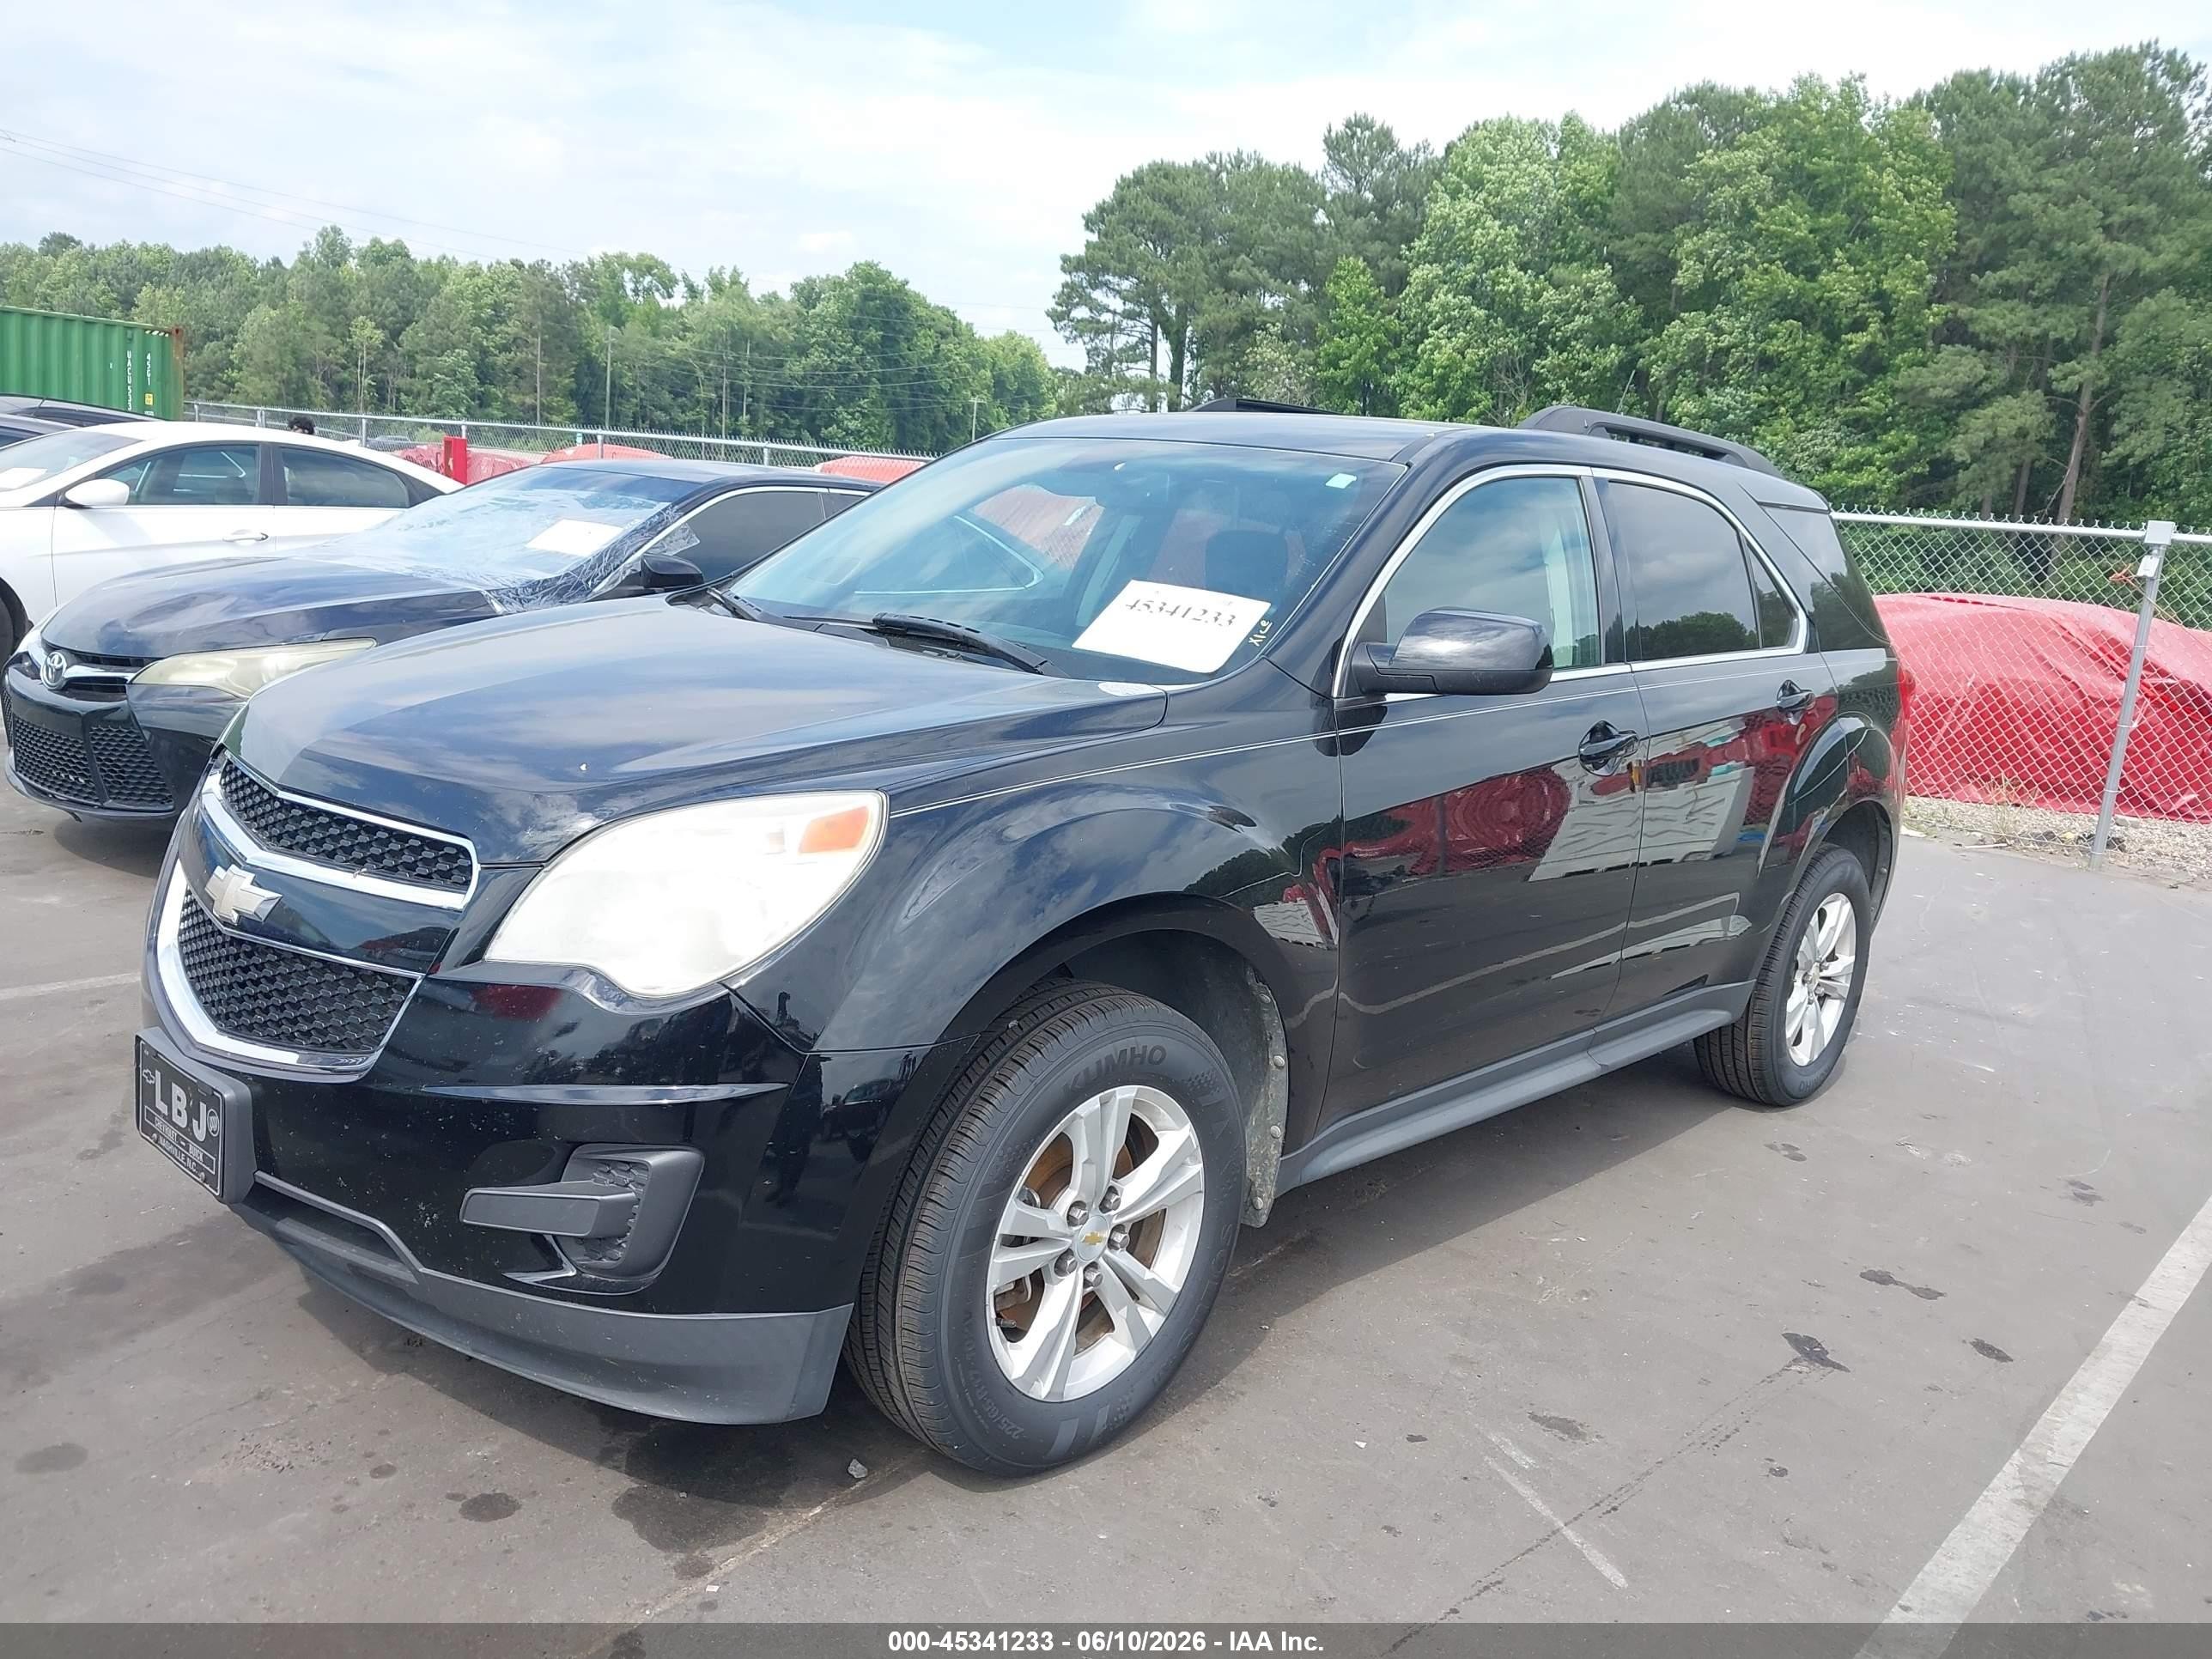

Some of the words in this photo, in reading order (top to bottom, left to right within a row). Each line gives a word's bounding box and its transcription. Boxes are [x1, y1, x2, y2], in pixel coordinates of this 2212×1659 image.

[1125, 599, 1237, 627] 45341233
[155, 1069, 207, 1142] LBJ
[189, 1144, 204, 1163] BUICK
